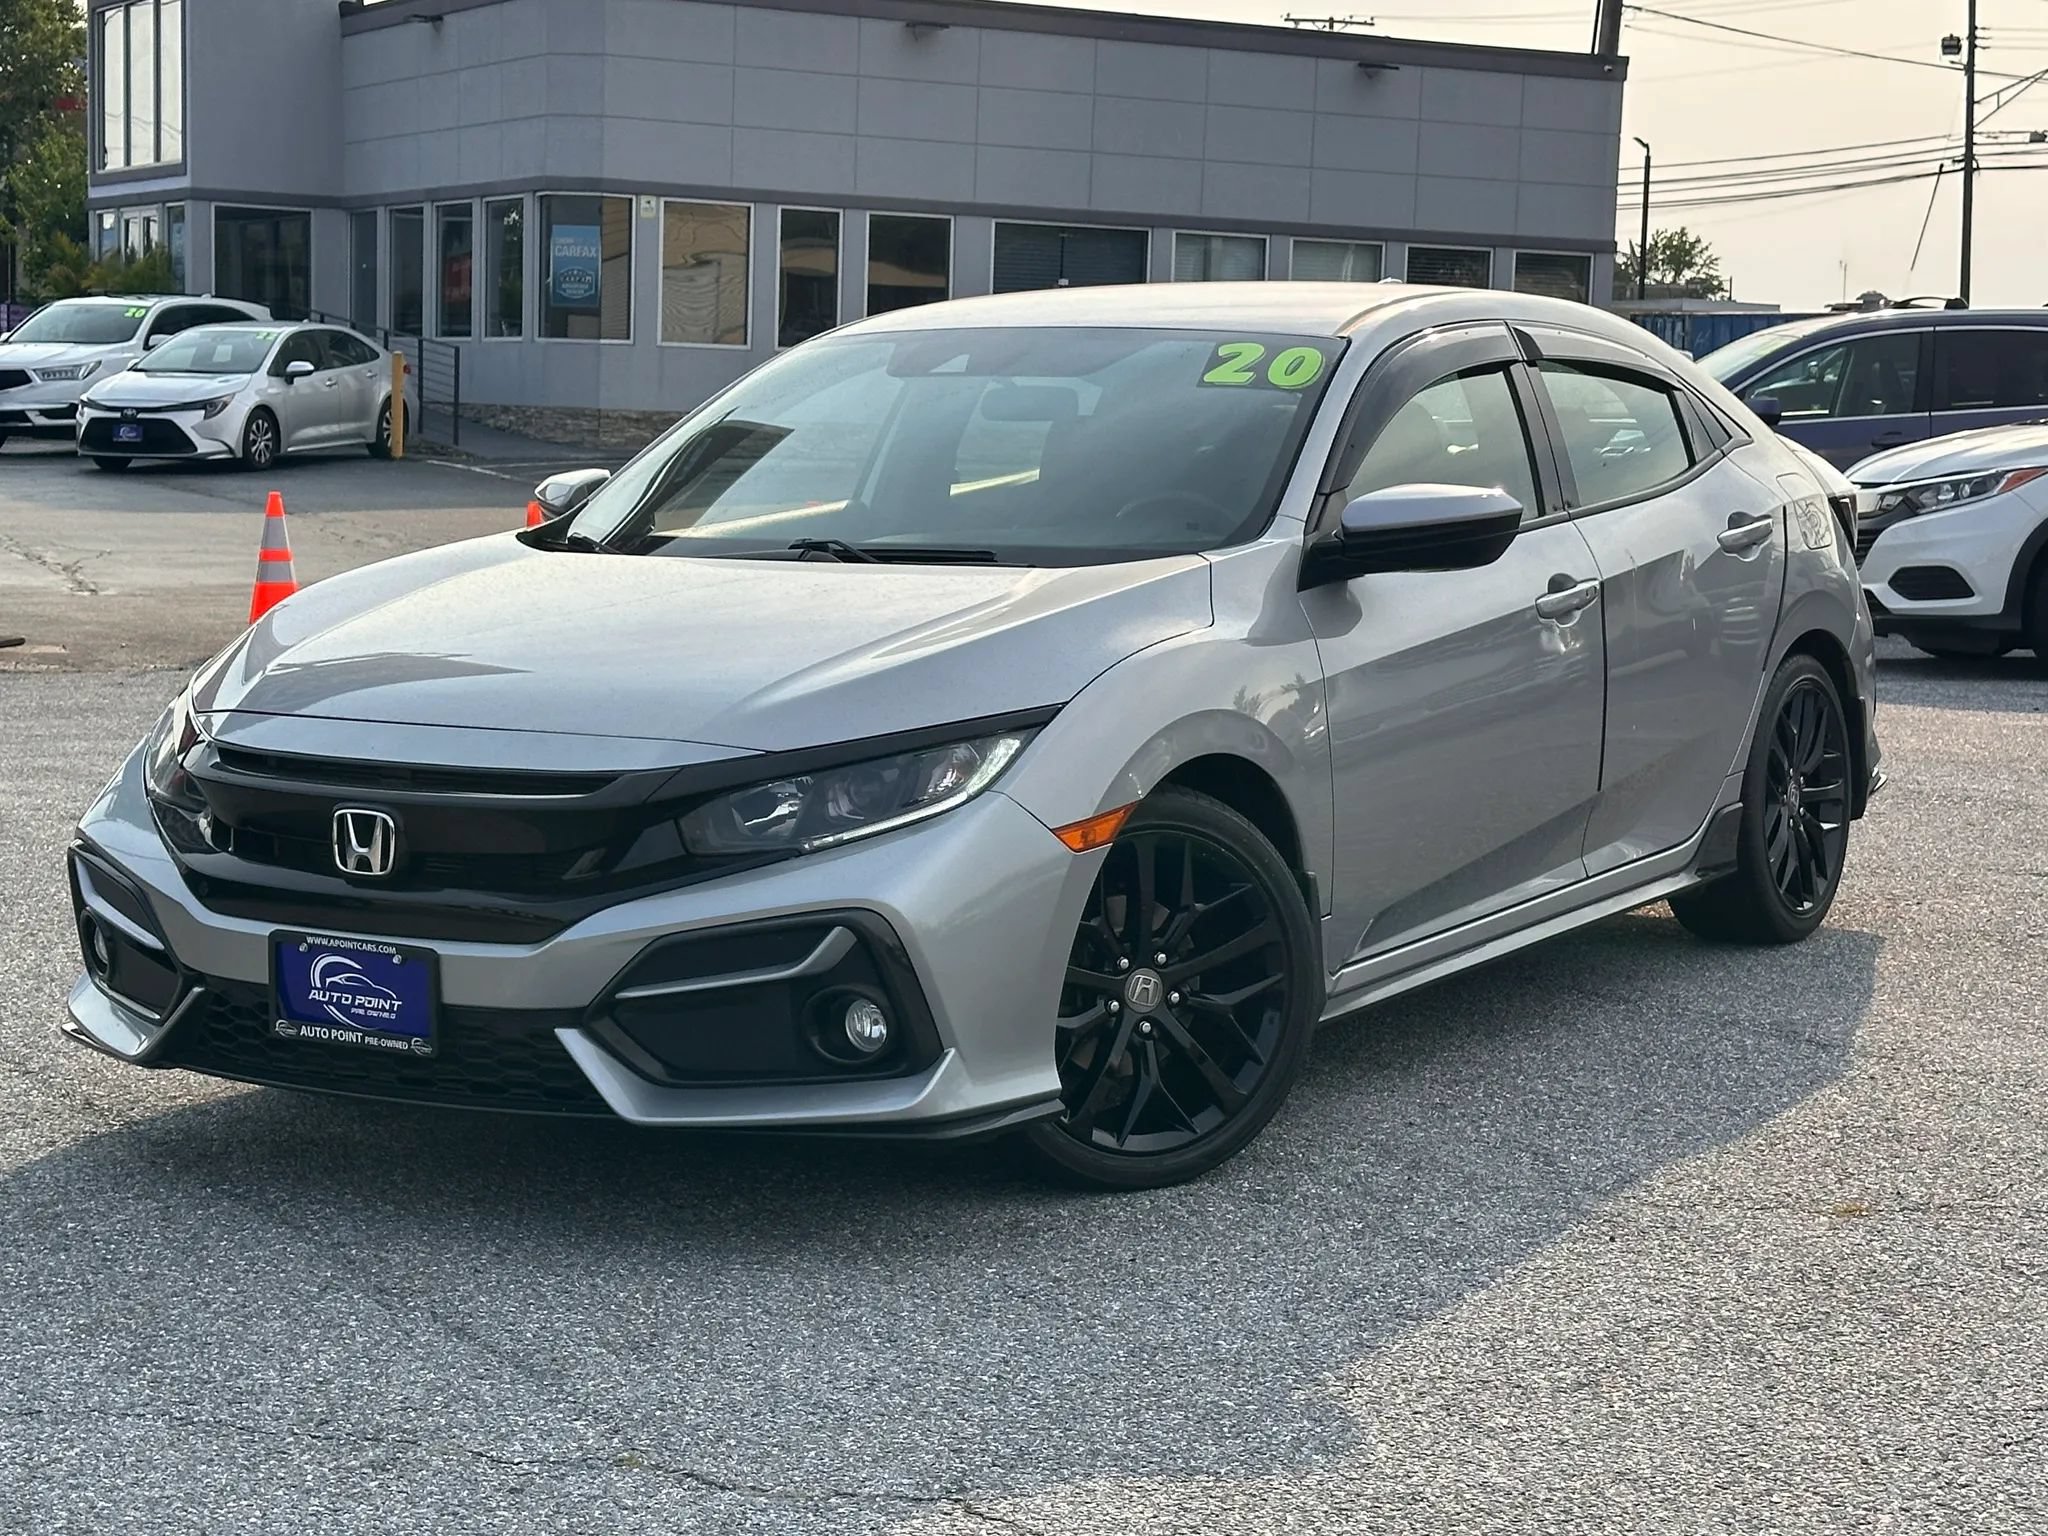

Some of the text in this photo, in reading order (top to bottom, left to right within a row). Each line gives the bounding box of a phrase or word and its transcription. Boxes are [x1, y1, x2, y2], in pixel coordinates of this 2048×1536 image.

[555, 245, 597, 258] CARFAX
[1203, 342, 1326, 389] 20
[306, 936, 397, 954] WWW.APOINTCARS.COM
[308, 989, 402, 1011] AUTO POINT
[300, 1025, 329, 1039] AUTO
[331, 1028, 363, 1044] POINT
[364, 1036, 408, 1050] PRE-OWNED
